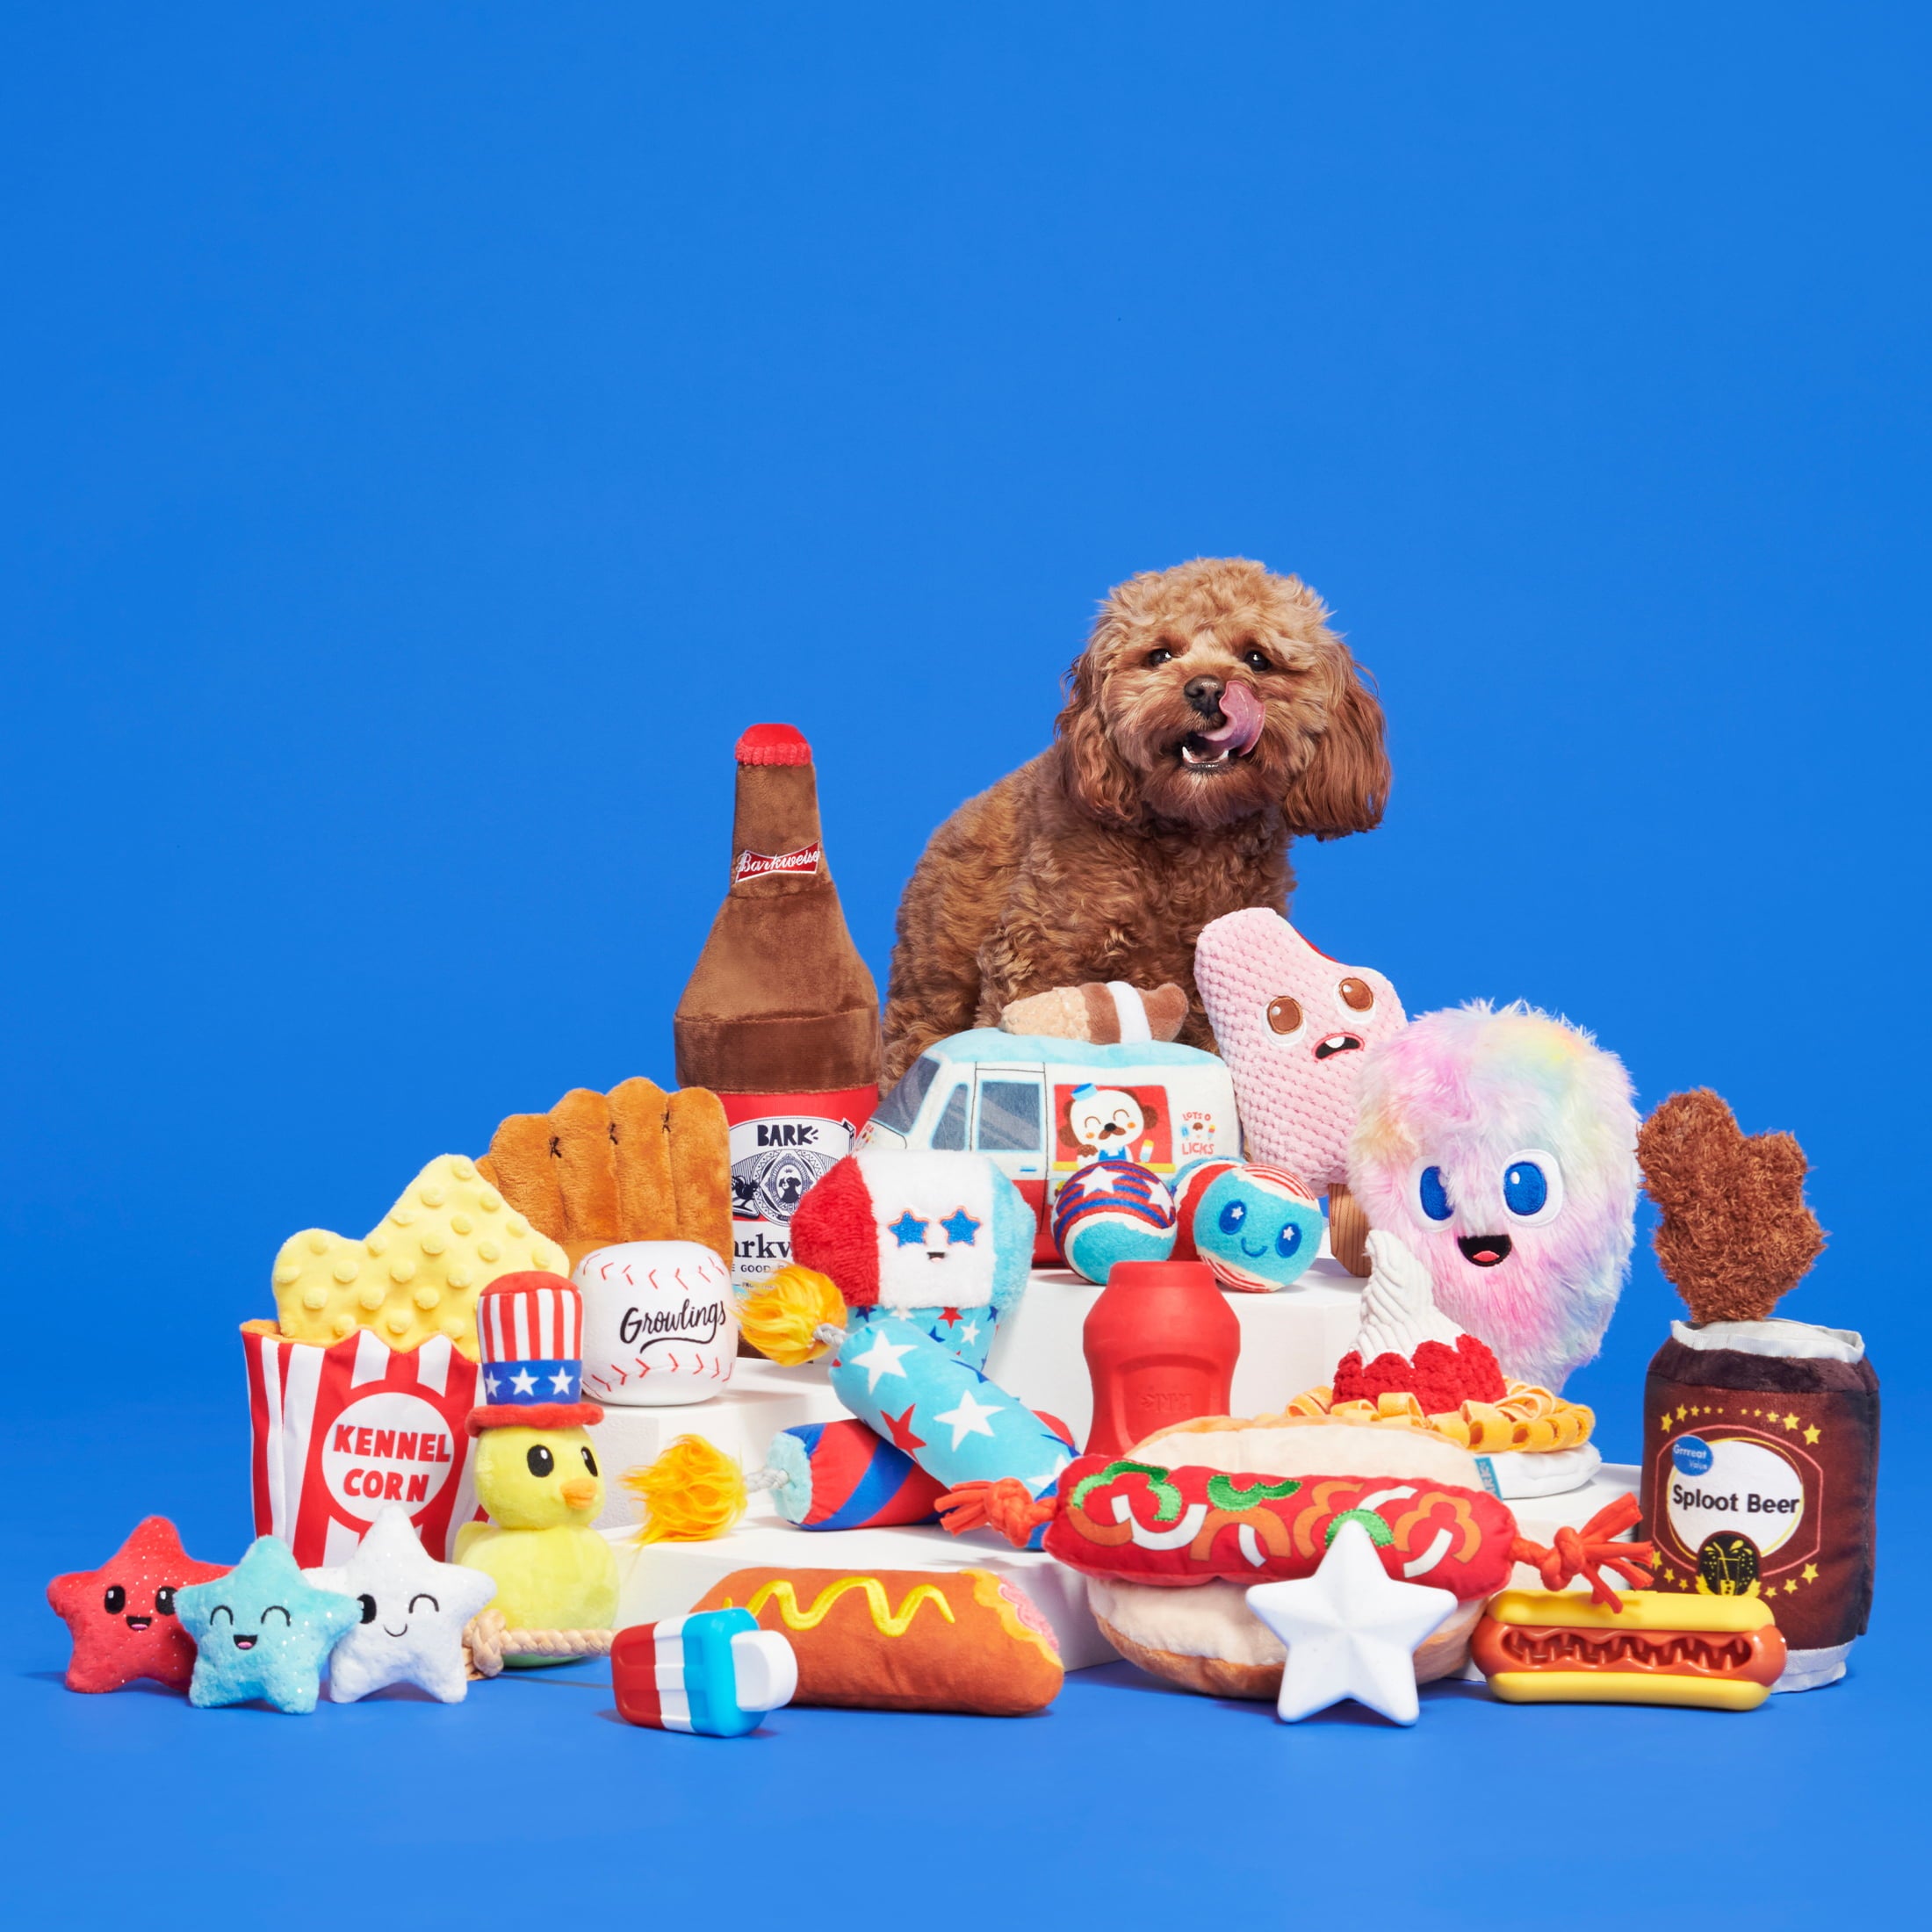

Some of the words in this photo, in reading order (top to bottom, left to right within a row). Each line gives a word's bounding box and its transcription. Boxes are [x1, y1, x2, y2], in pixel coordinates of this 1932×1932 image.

[1182, 1112, 1202, 1121] LOTS
[757, 1124, 813, 1147] BARK
[1181, 1142, 1215, 1156] LICKS
[619, 1298, 726, 1353] Growlings
[333, 1424, 451, 1463] KENNEL
[343, 1468, 429, 1503] CORN
[1672, 1484, 1740, 1511] Sploot
[1747, 1493, 1800, 1513] Beer
